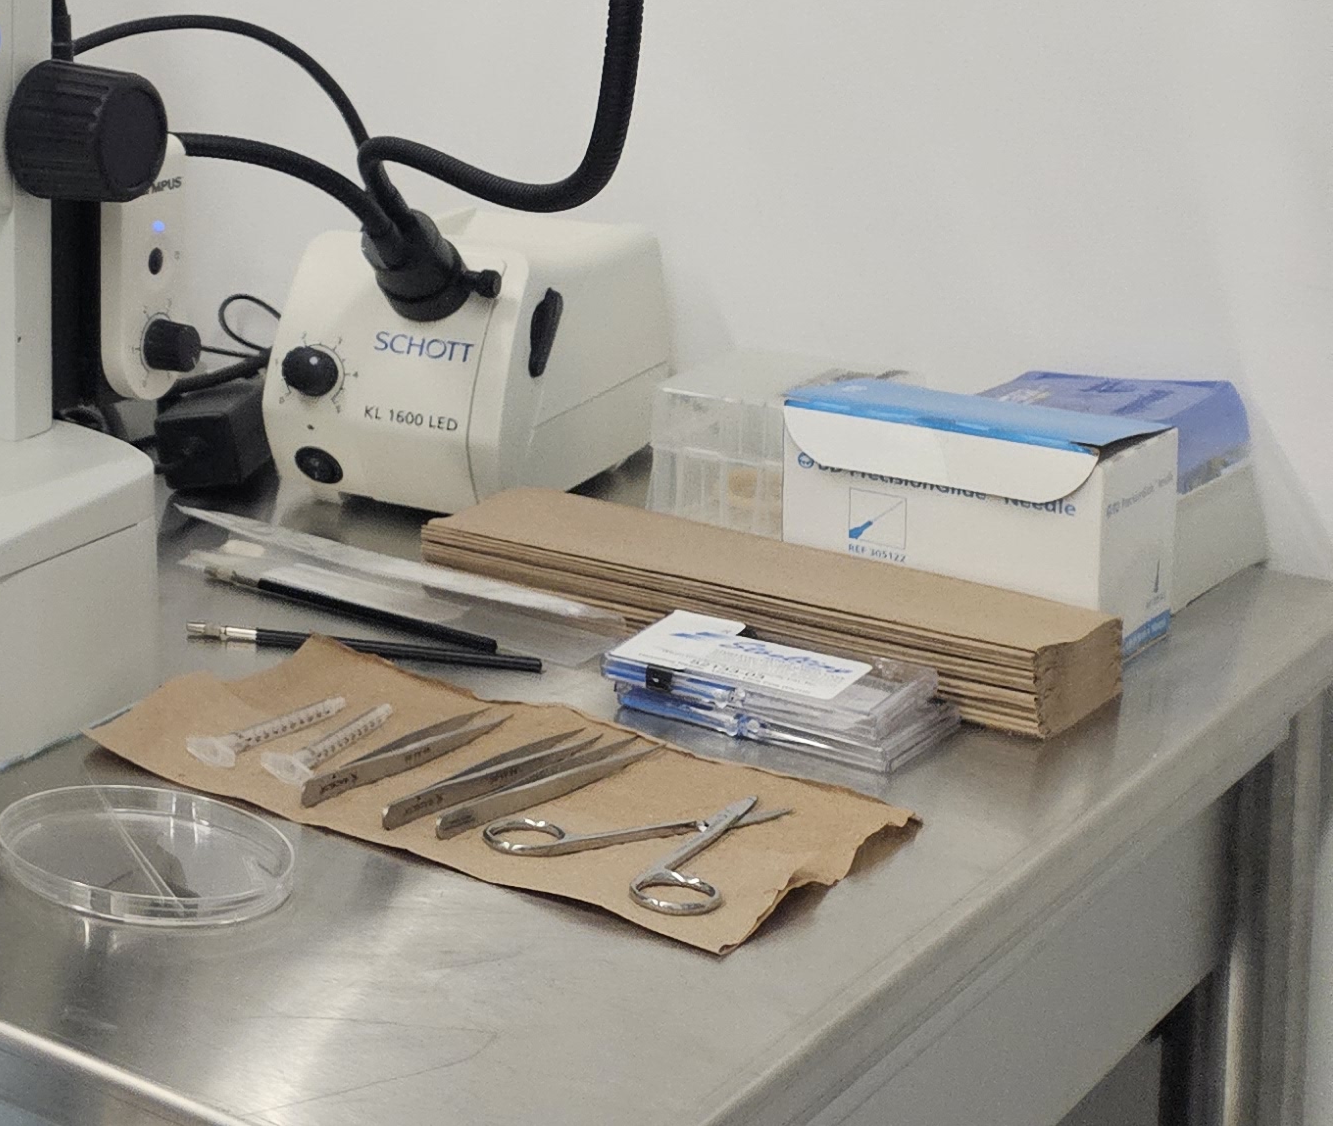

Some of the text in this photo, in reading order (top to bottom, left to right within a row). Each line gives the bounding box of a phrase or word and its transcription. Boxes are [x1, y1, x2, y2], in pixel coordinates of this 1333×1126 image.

[374, 331, 475, 363] SCHOTT
[364, 406, 459, 432] KL 1600 LED
